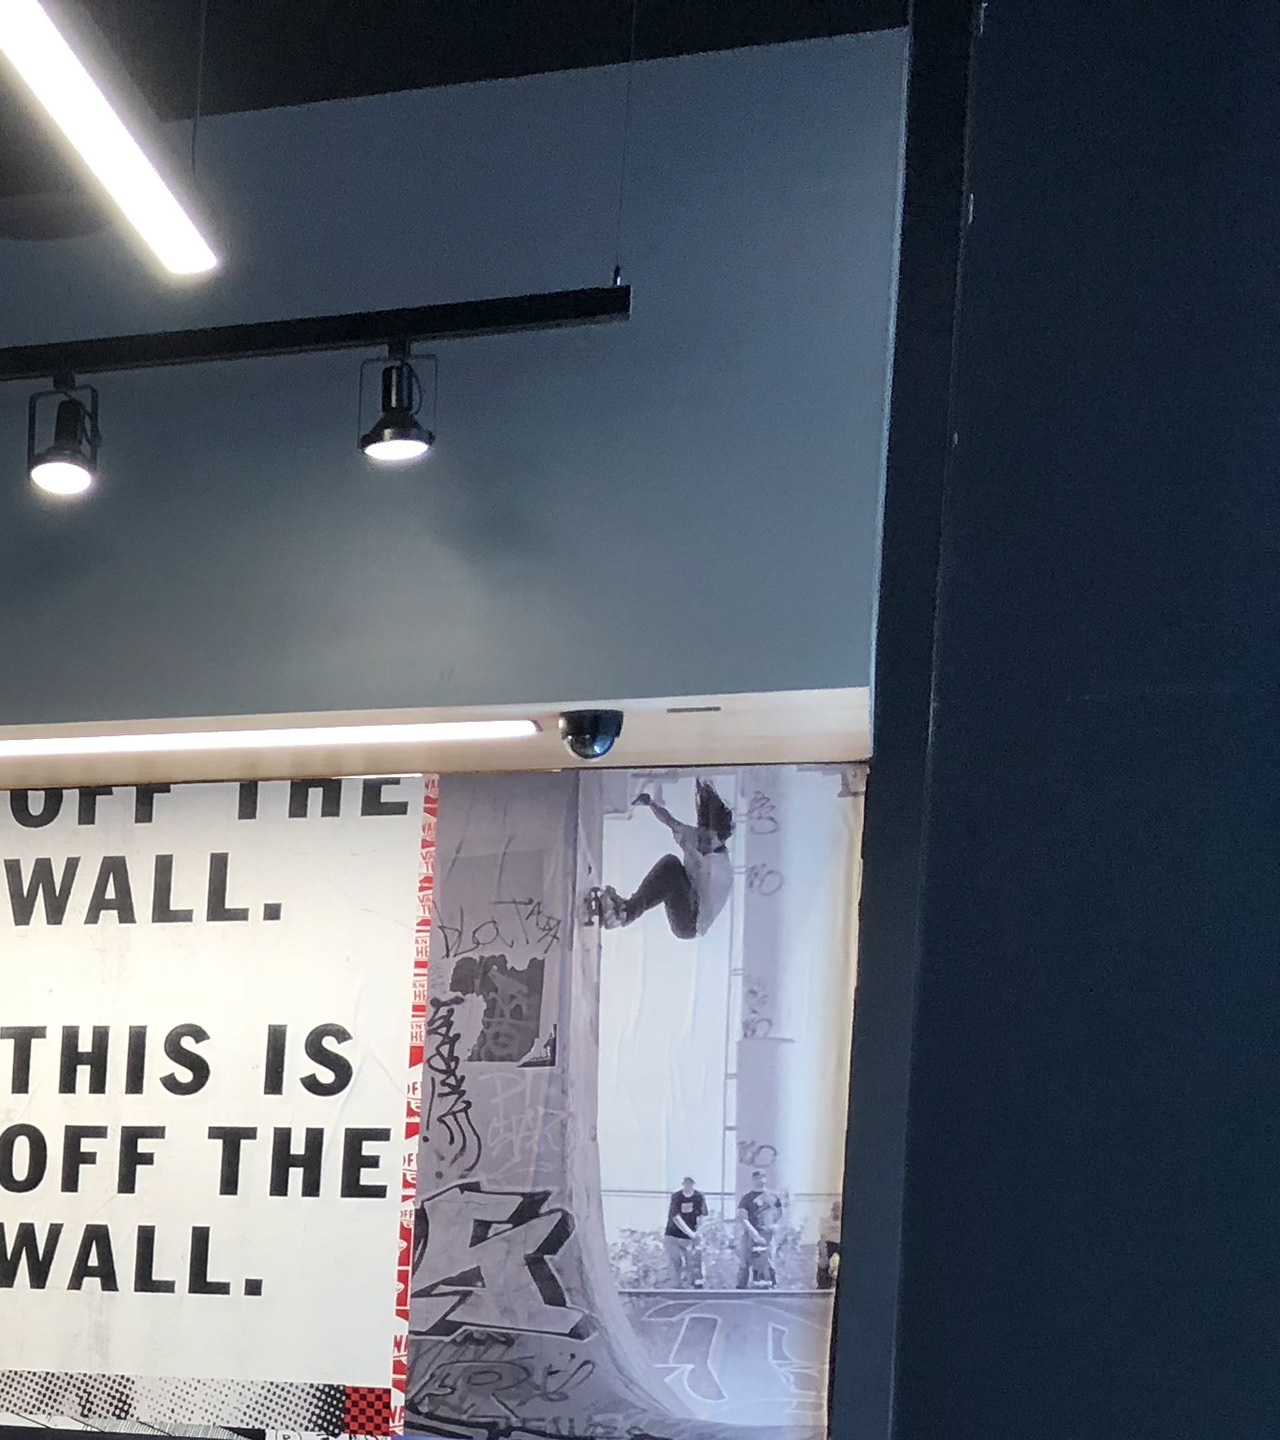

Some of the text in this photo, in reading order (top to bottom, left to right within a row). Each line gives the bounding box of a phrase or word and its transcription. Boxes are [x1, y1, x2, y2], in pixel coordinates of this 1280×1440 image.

[3, 852, 282, 925] WALL.
[0, 1023, 353, 1096] THIS IS
[207, 1126, 391, 1199] THE
